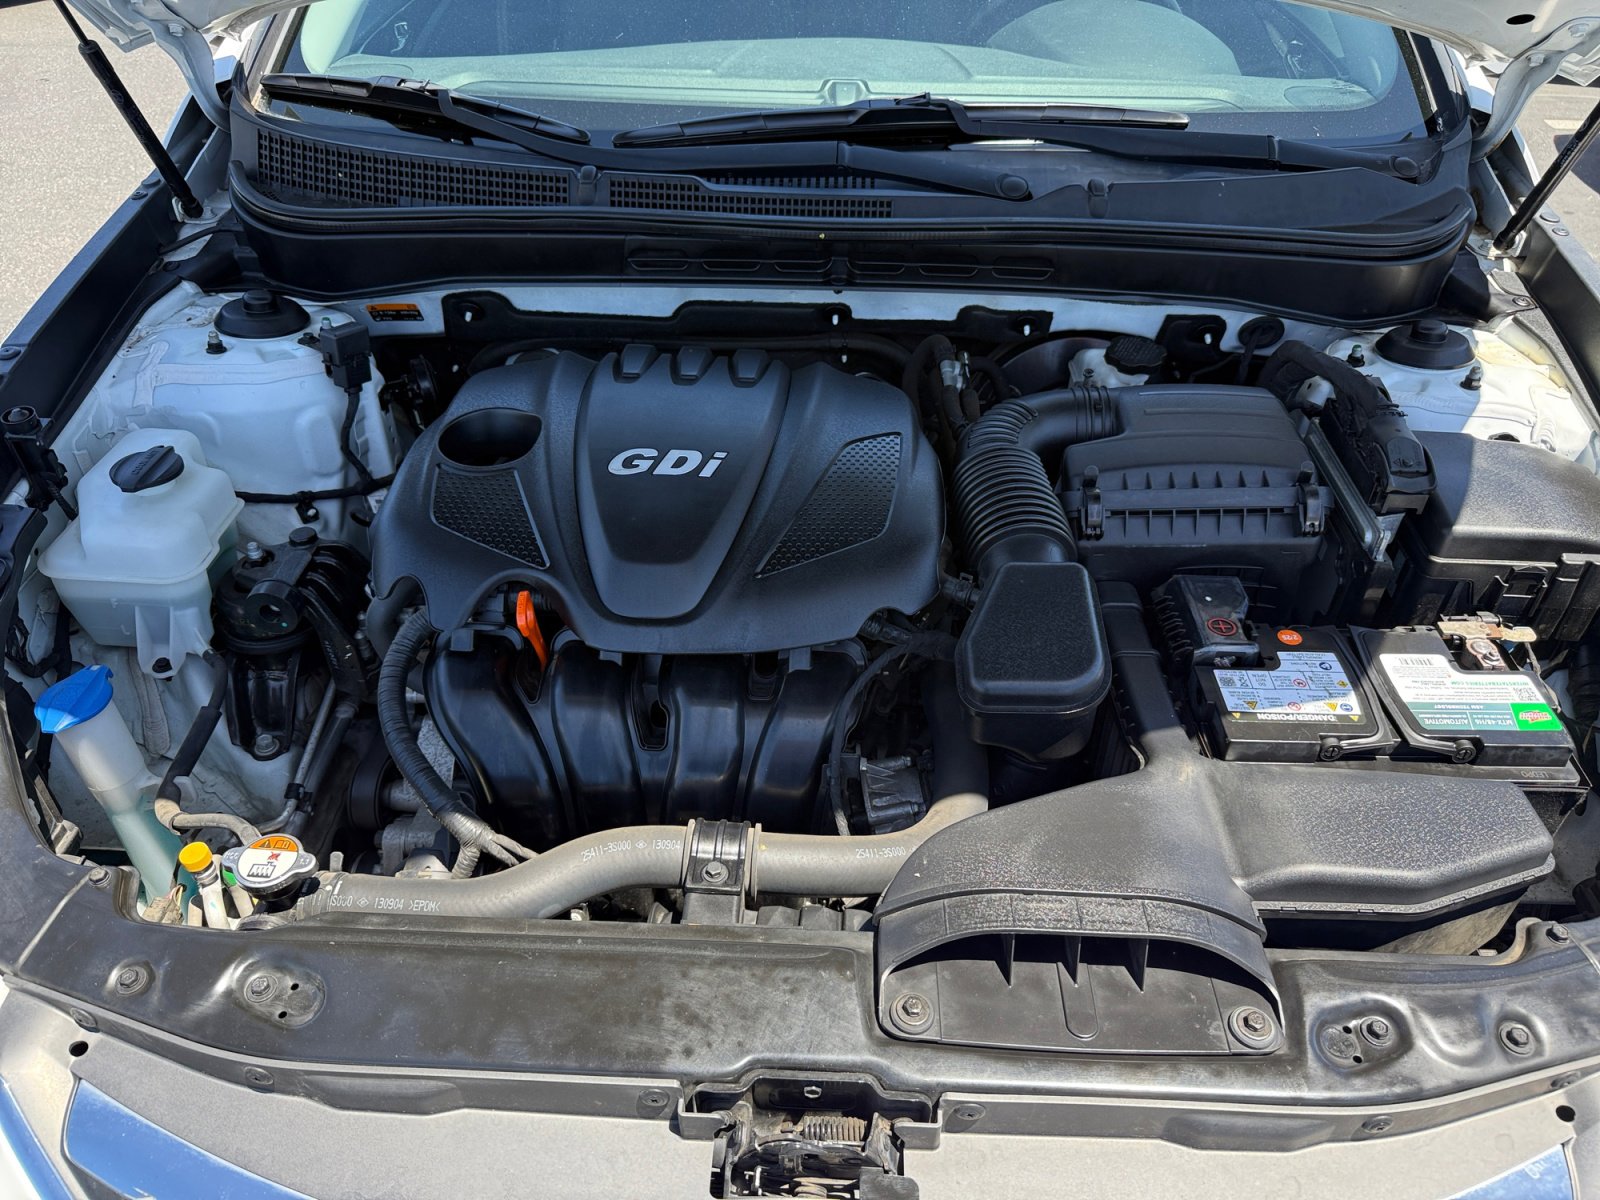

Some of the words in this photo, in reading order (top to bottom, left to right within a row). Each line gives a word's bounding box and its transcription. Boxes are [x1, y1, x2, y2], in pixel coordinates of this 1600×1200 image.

[608, 447, 729, 478] GDi
[1257, 712, 1337, 721] DANGER/POISON
[652, 839, 681, 850] 130904
[374, 897, 405, 910] 130904
